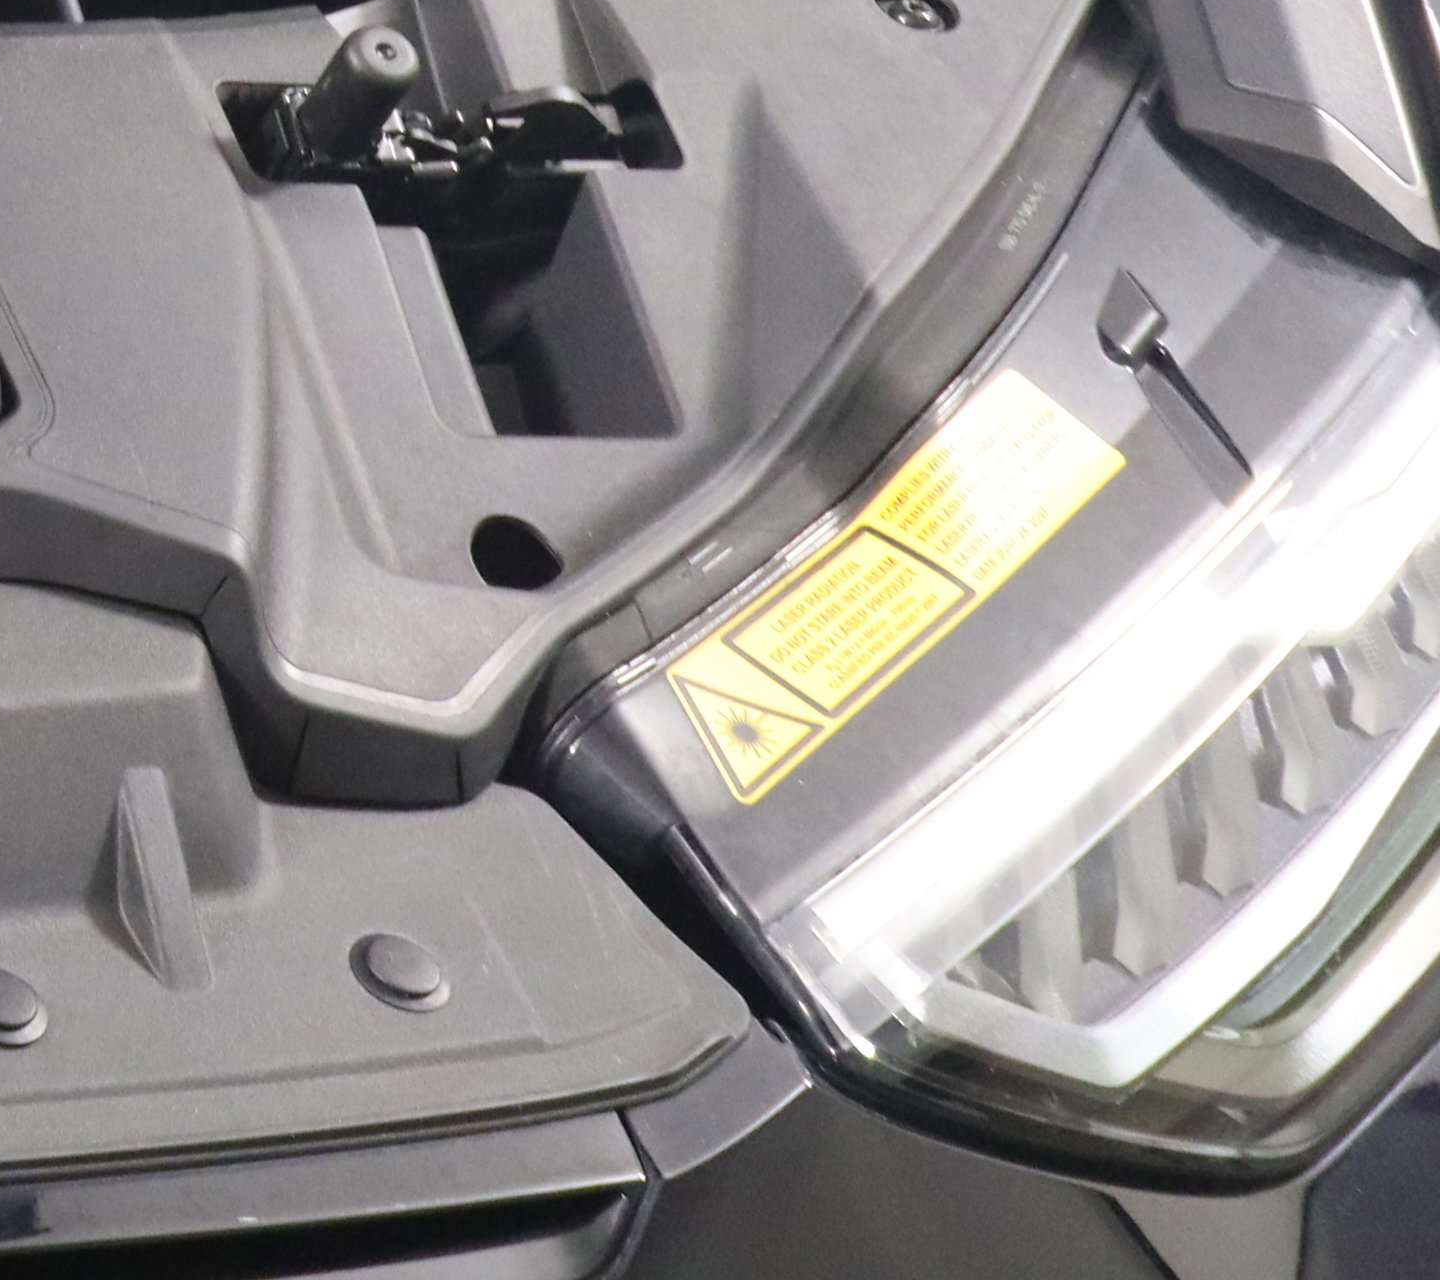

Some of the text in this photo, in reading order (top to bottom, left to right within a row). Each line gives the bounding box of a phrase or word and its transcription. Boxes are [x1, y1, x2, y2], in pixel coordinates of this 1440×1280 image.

[876, 467, 932, 522] COMPLIES
[914, 518, 943, 544] FOR
[767, 601, 811, 635] LASER
[800, 557, 862, 607] RADIATION
[768, 554, 898, 664] DO NOT STARE INTO BEAM
[790, 642, 830, 675] CLASS
[836, 607, 870, 641] LASER
[864, 566, 918, 610] PRODUCT
